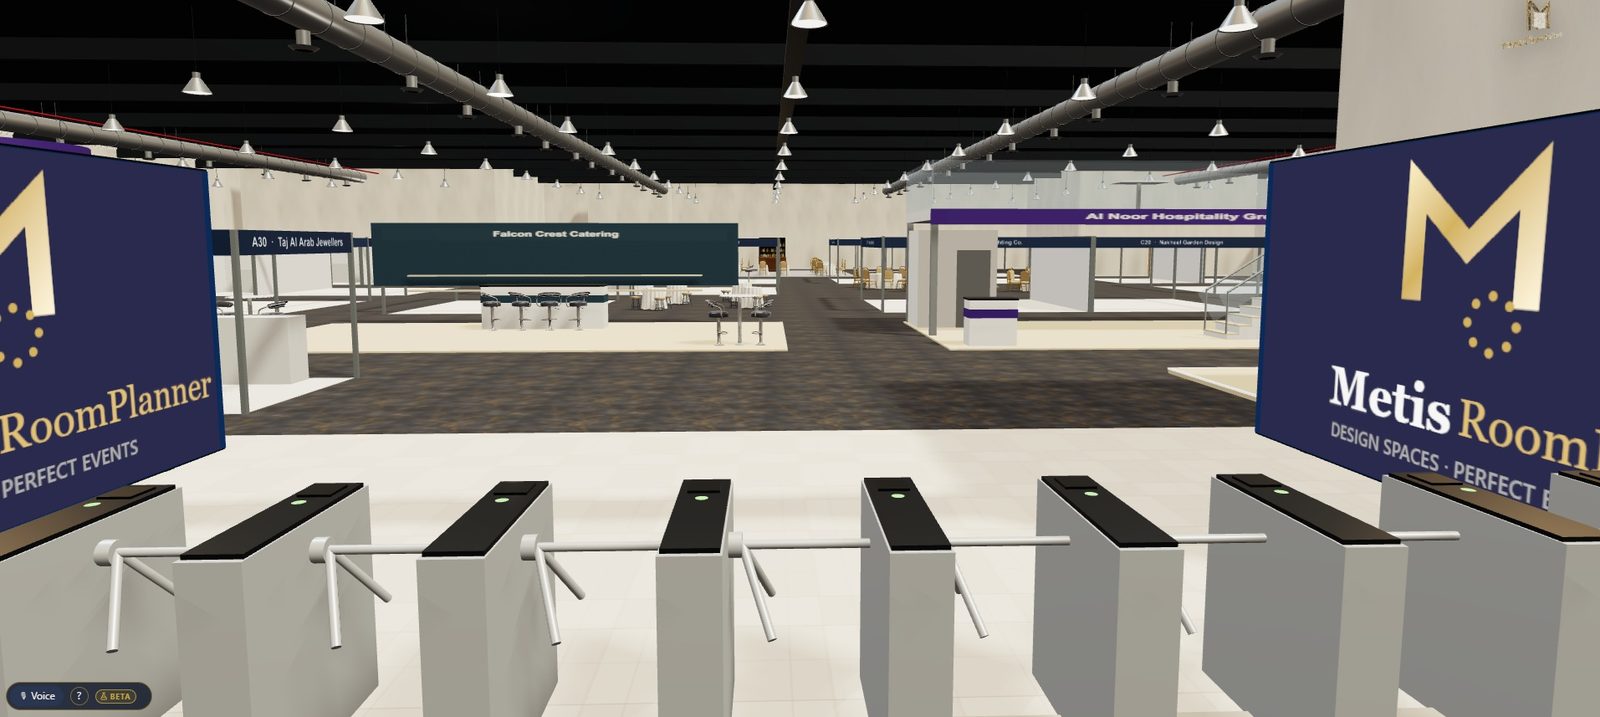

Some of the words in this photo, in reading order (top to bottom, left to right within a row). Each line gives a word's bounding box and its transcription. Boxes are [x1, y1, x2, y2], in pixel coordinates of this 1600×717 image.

[252, 236, 267, 248] A30
[278, 237, 289, 250] Taj
[290, 237, 298, 248] Al
[299, 237, 314, 247] Arab
[316, 237, 344, 247] Jewellers
[492, 230, 532, 238] Falcon
[535, 230, 567, 238] Crest
[569, 230, 620, 239] Catering
[1086, 212, 1104, 220] Al
[1108, 212, 1150, 220] Noor
[1152, 212, 1240, 222] Hospitality
[1204, 239, 1224, 247] Design
[1401, 140, 1554, 312] M
[0, 376, 212, 454] RoomPlanner
[1328, 364, 1451, 435] Metis
[1458, 398, 1600, 470] Room
[2, 458, 77, 499] PERFECT
[82, 439, 139, 472] EVENTS
[1330, 421, 1379, 453] DESIGN
[1383, 441, 1440, 472] SPACES
[1454, 460, 1537, 504] PERFECT
